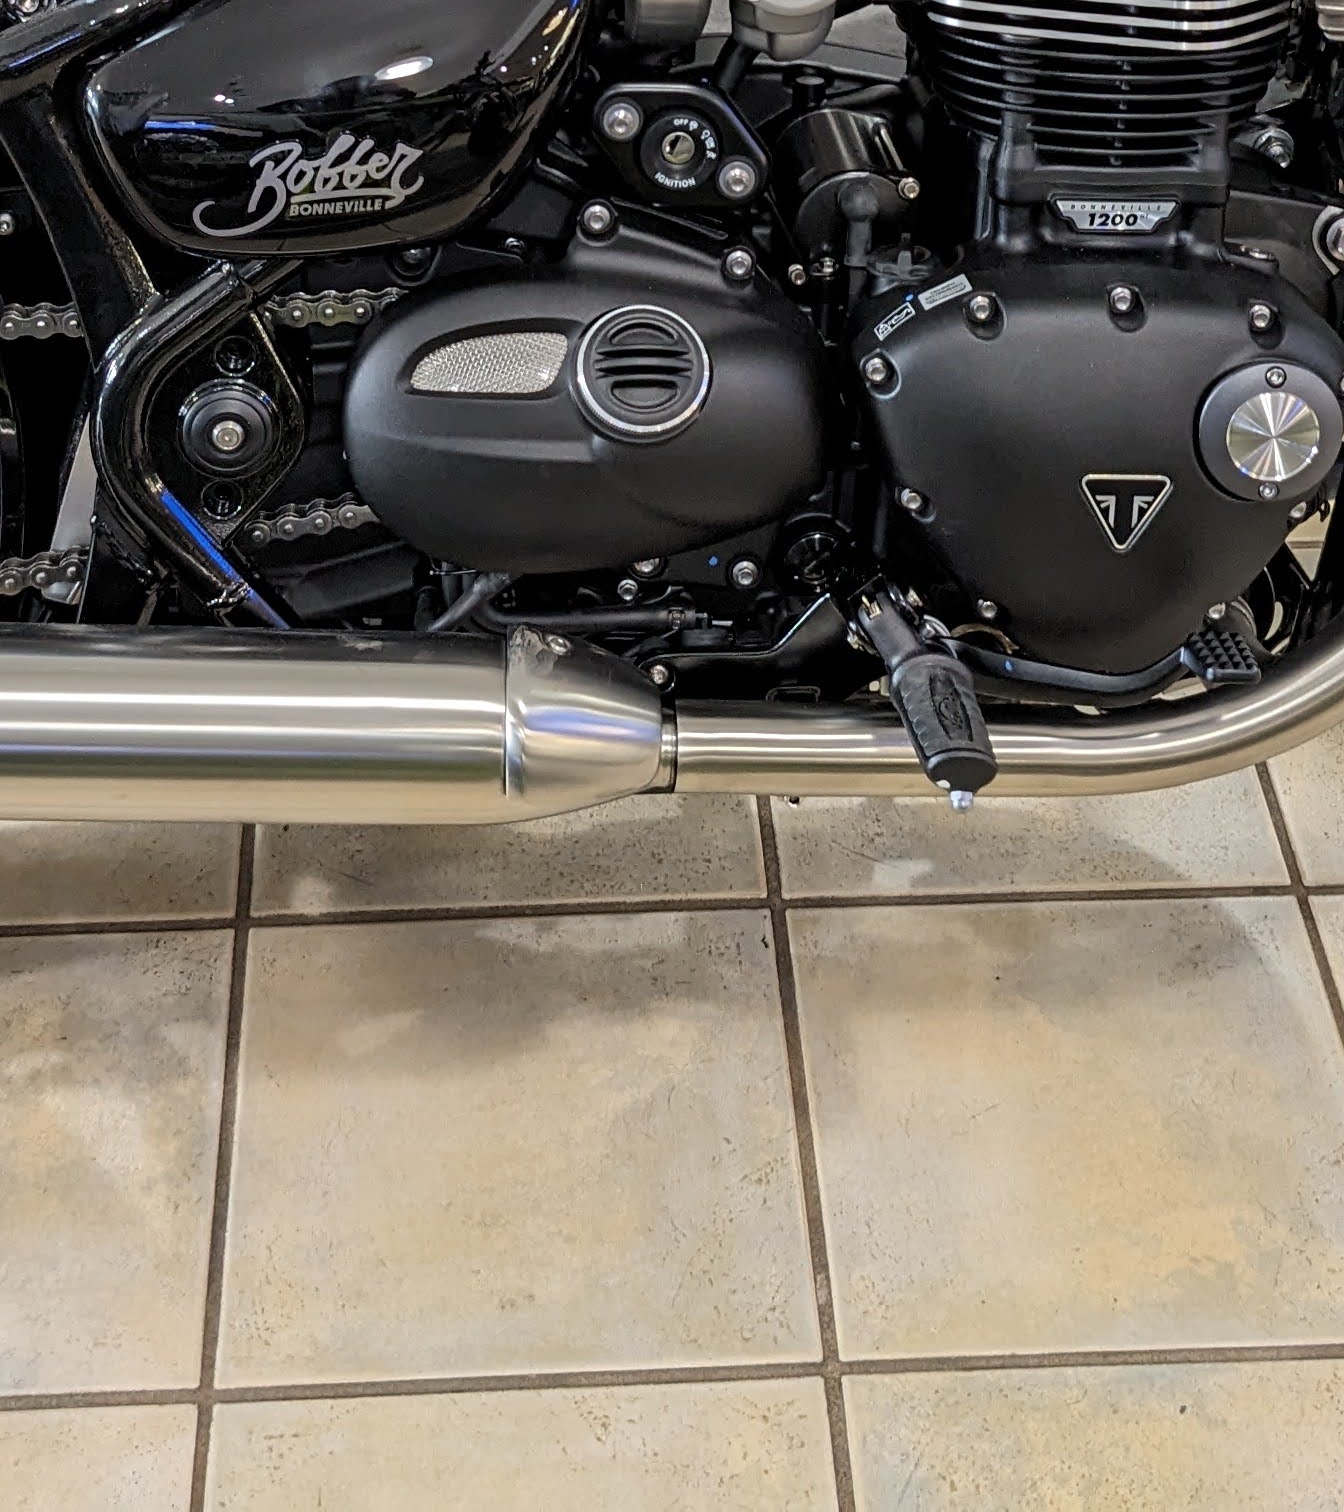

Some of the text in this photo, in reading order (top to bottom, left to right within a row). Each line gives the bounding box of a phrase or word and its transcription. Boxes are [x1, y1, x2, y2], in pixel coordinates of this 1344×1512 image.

[673, 118, 689, 126] OFF
[192, 130, 425, 237] Bobber
[655, 171, 697, 188] IGNITION
[289, 197, 384, 218] BONNEVILLE
[1070, 204, 1162, 212] BONNEVILLE
[1088, 213, 1138, 227] 1200
